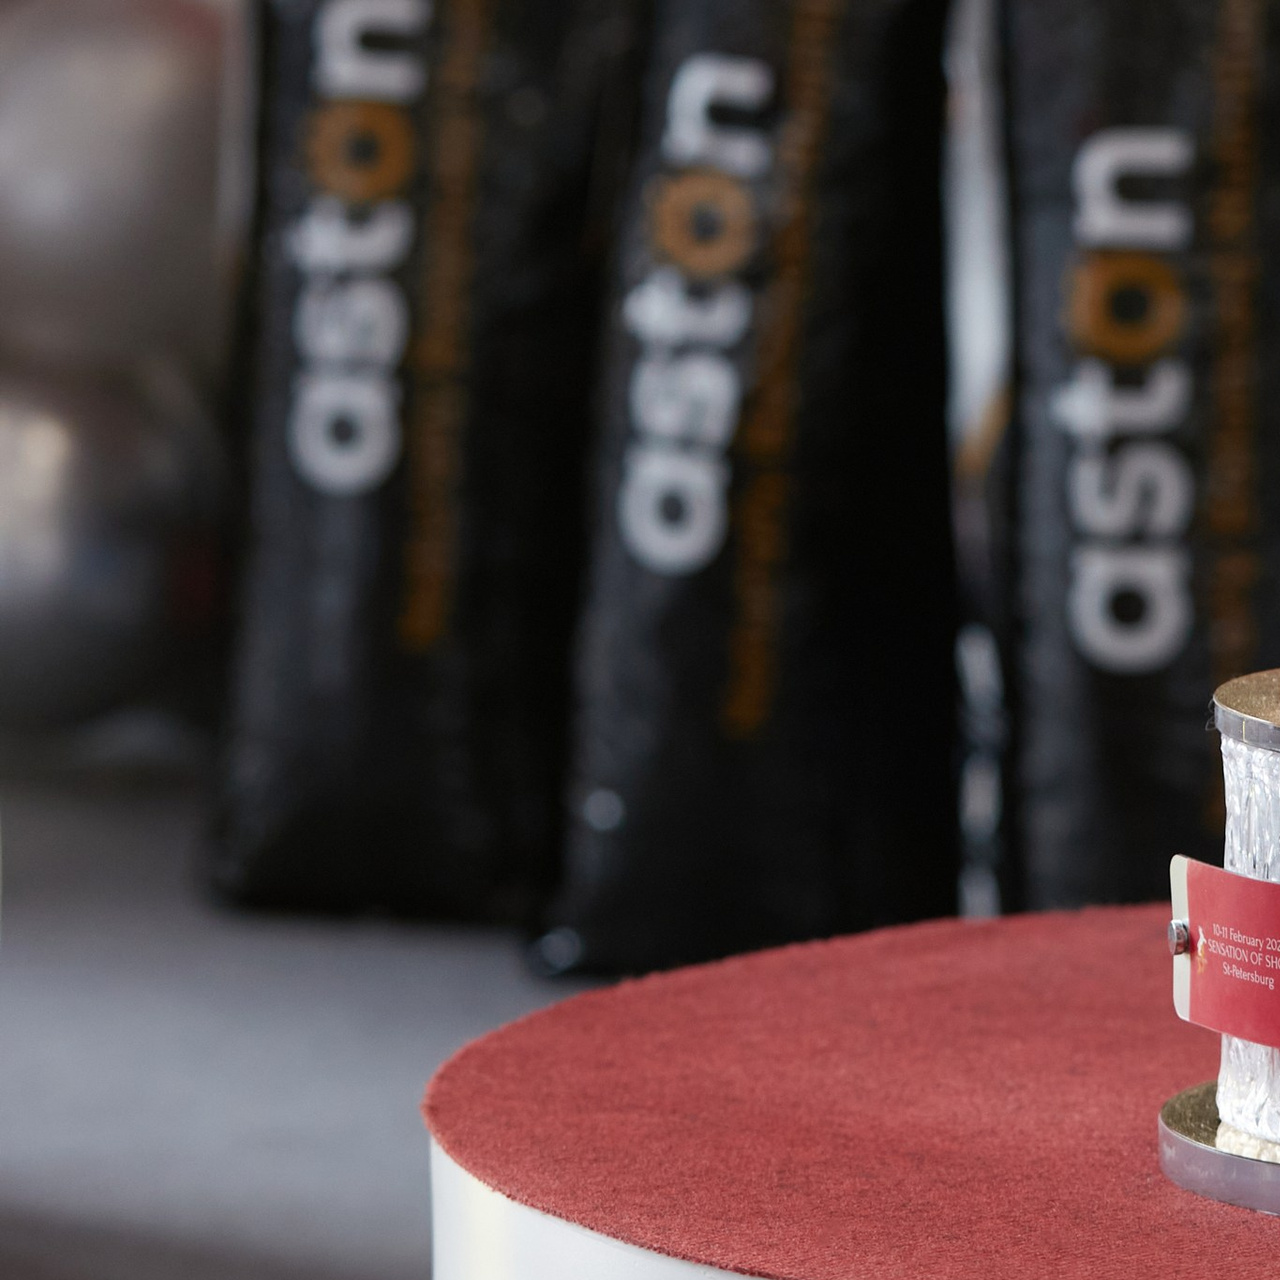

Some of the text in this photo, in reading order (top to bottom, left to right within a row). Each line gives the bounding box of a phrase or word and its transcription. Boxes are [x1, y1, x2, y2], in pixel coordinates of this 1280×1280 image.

[618, 52, 775, 575] aston
[1058, 124, 1196, 674] aston
[1213, 923, 1227, 938] 10-11
[1229, 928, 1264, 948] February
[1207, 938, 1249, 963] SENSATION
[1250, 951, 1263, 966] OF
[1222, 961, 1275, 990] St-Petersburg
